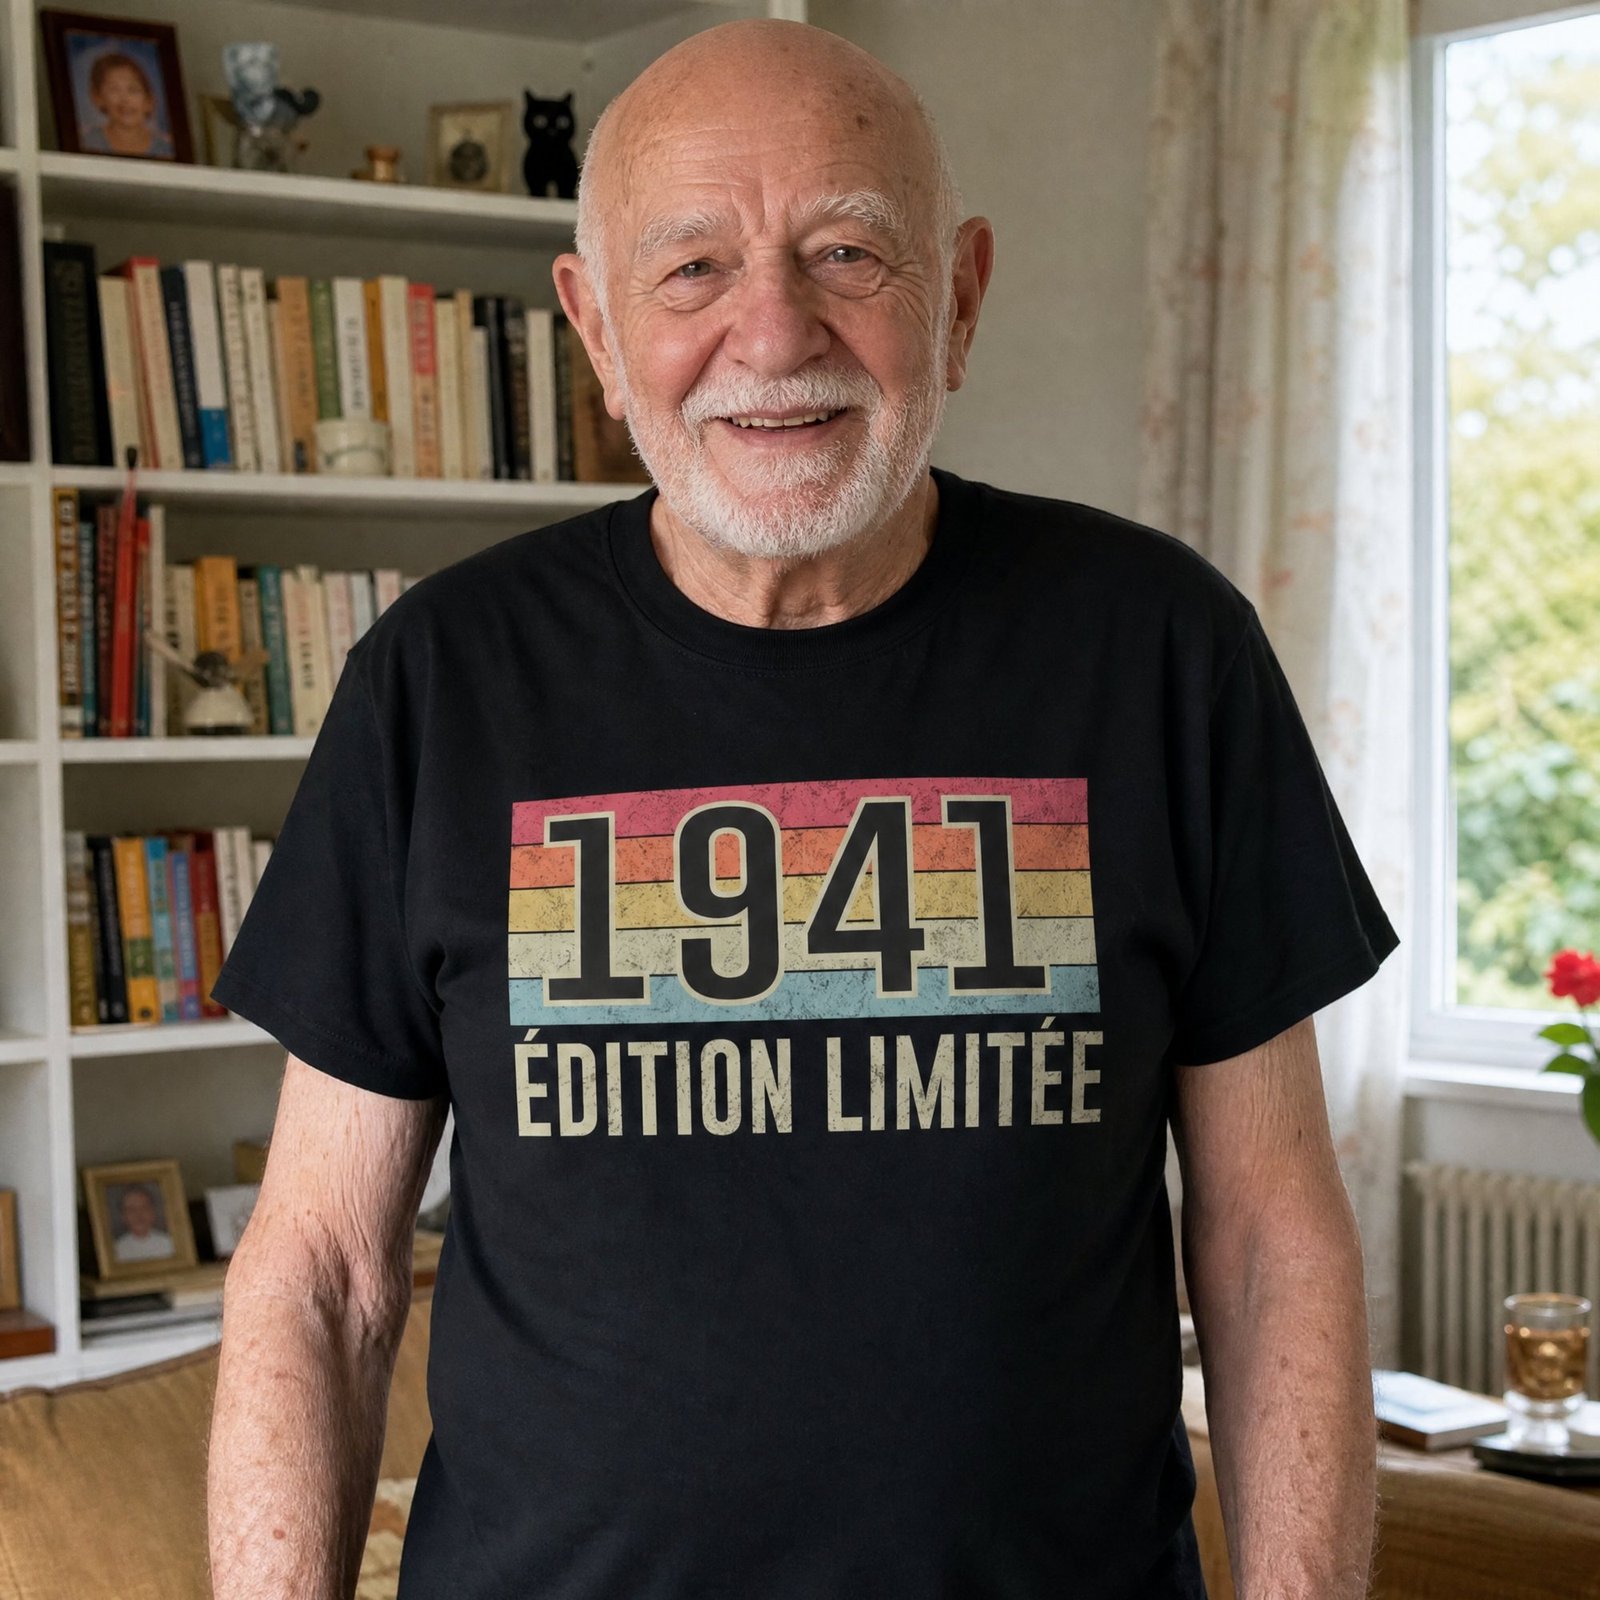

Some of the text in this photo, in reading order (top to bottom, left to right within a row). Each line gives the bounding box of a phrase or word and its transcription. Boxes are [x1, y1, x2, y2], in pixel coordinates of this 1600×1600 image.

[543, 795, 1051, 1006] 1941
[514, 1016, 1103, 1136] ÉDITION LIMITÉE
